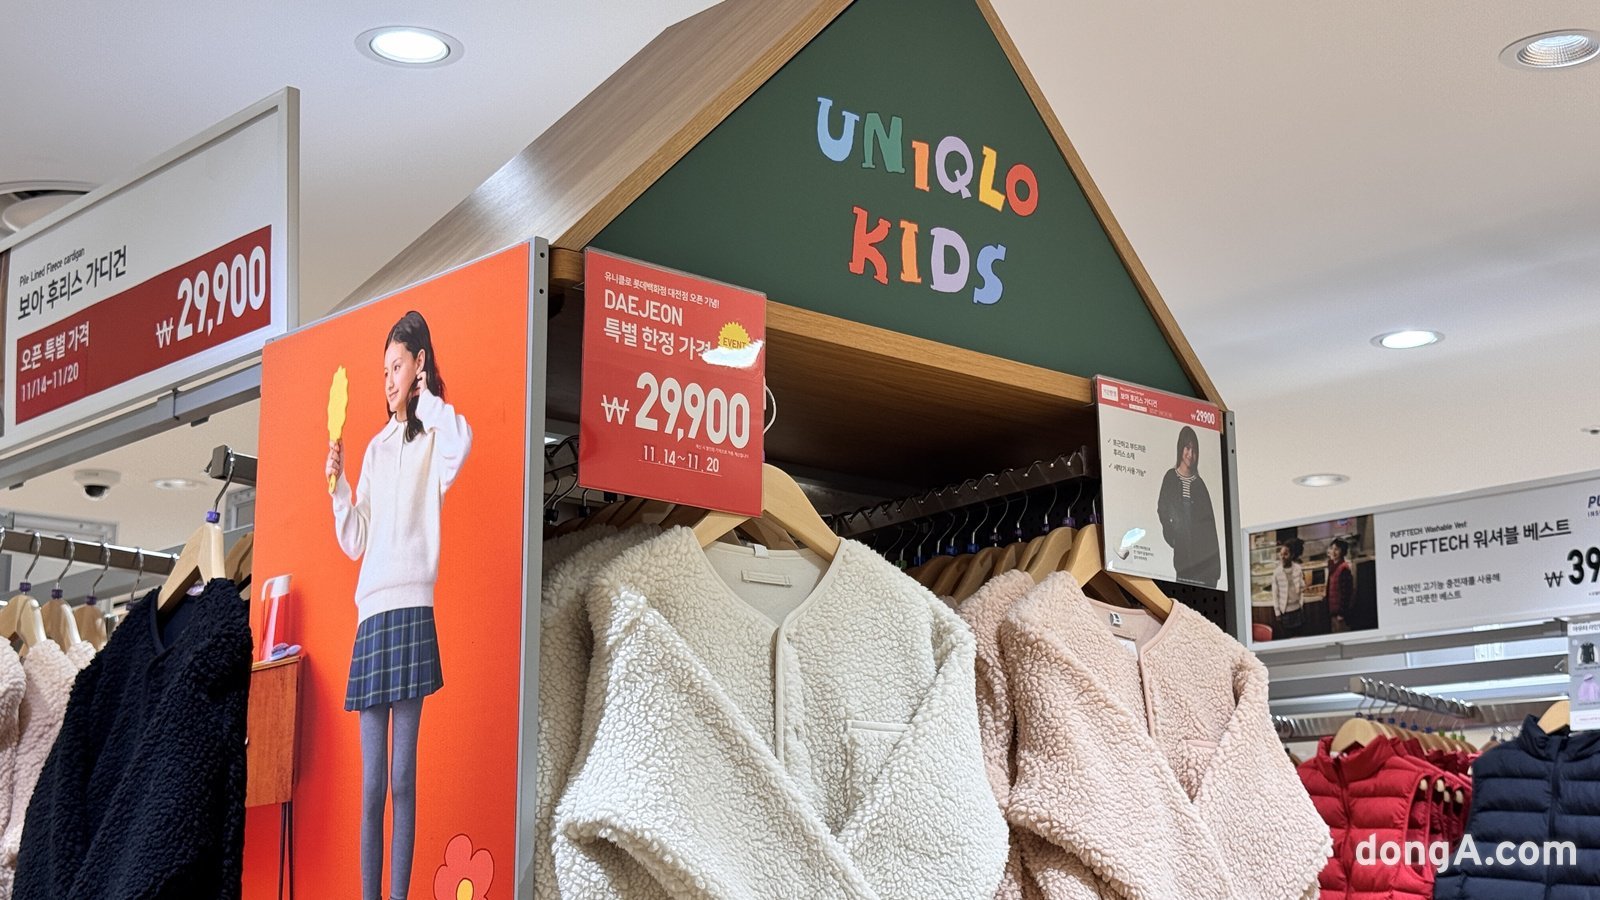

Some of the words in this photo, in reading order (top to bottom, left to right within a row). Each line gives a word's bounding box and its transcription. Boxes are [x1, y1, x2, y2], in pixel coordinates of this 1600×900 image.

[817, 97, 1039, 217] UNIQLO
[30, 265, 46, 281] Lined
[849, 206, 1006, 304] KIDS
[18, 286, 44, 320] 보아
[46, 269, 83, 309] 후리스
[86, 245, 127, 288] 가디건
[604, 271, 633, 287] 유니클로
[633, 279, 667, 297] 롯데백화점
[667, 288, 689, 302] 대전점
[689, 293, 704, 305] 오픈
[604, 289, 683, 326] DAEJEON
[20, 343, 42, 372] 오픈
[45, 331, 66, 362] 특별
[68, 320, 90, 351] 가격
[604, 317, 637, 348] 특별
[642, 326, 674, 356] 한정
[723, 337, 746, 349] EVENT
[1390, 529, 1423, 538] PUFFTECH
[1424, 524, 1453, 534] Washable
[1454, 521, 1467, 530] Vest
[1391, 533, 1469, 559] PUFFTECH
[1473, 526, 1519, 549] 워셔블
[1523, 519, 1572, 541] 베스트
[1392, 583, 1421, 595] 혁신적인
[1422, 580, 1444, 591] 고기능
[1477, 572, 1500, 584] 사용해
[1393, 596, 1415, 606] 가볍고
[1439, 590, 1462, 601] 베스트
